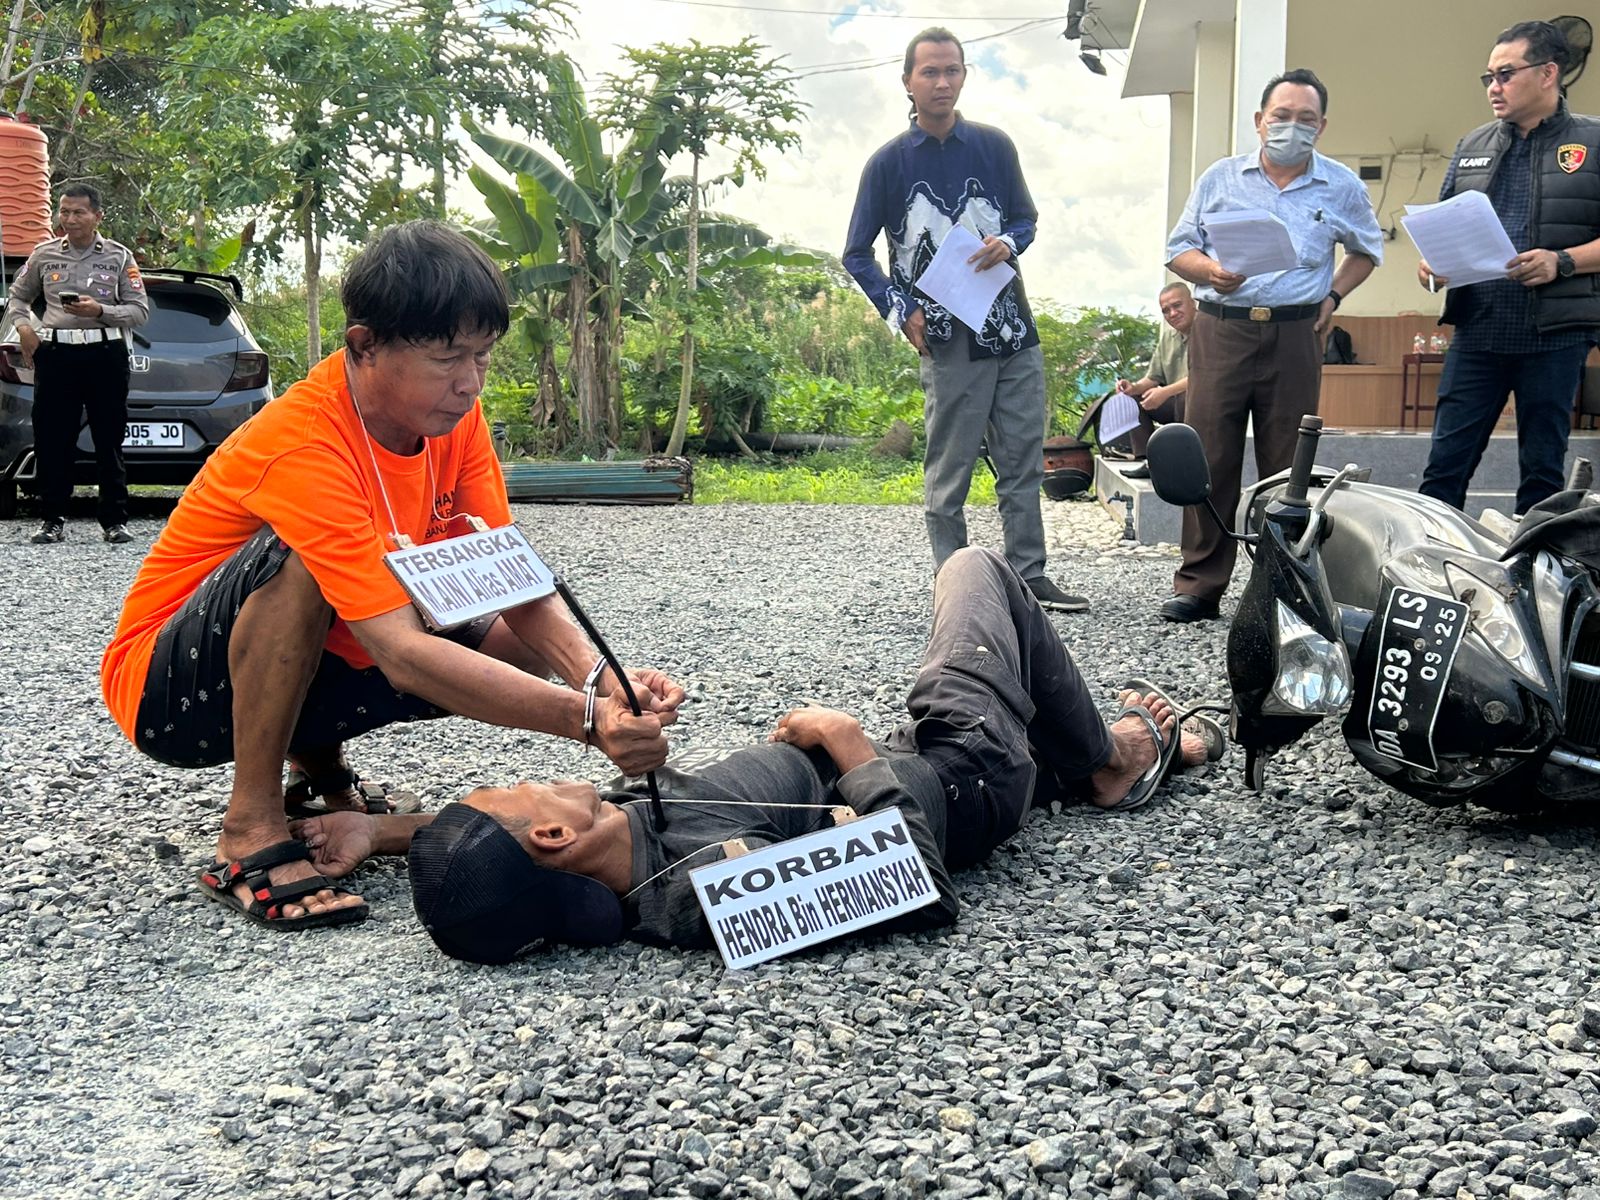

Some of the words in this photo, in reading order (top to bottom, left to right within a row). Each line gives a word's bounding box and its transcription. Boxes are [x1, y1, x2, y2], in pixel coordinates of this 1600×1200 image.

[1459, 157, 1491, 168] KANIT
[92, 263, 118, 272] POLRI
[394, 531, 523, 576] TERSANGKA
[461, 567, 508, 602] Alias
[495, 553, 543, 591] AMAT
[1392, 593, 1428, 630] LS
[1377, 647, 1412, 717] 3293
[1374, 728, 1404, 758] DA
[703, 823, 909, 907] KORBAN
[717, 901, 797, 960] HENDRA
[786, 893, 824, 937] Bin
[814, 856, 931, 928] HERMANSYAH
